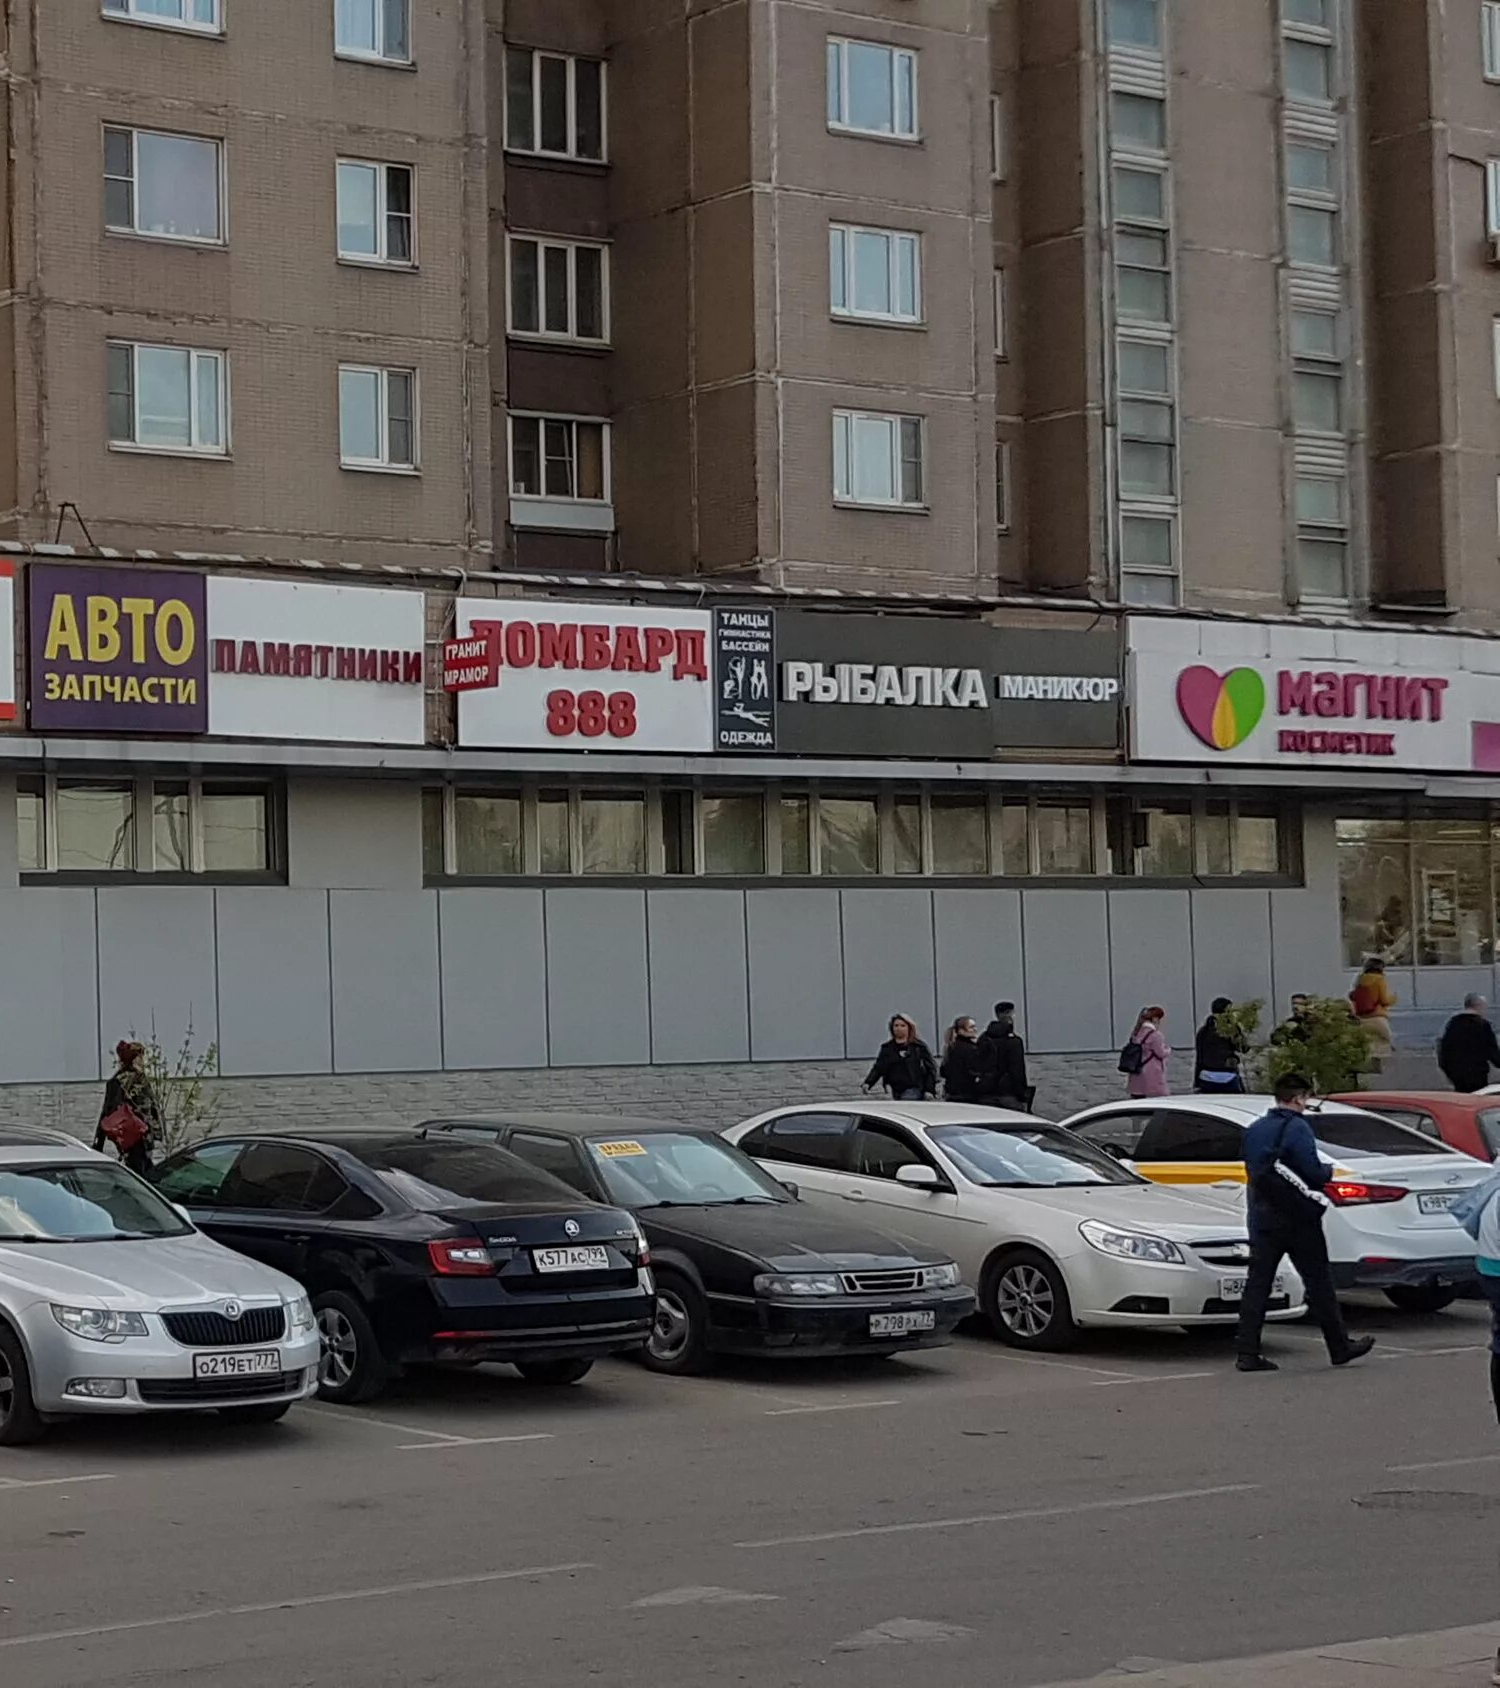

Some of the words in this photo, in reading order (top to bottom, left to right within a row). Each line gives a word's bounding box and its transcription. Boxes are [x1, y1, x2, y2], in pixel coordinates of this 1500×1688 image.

[44, 594, 195, 666] АВТО
[721, 613, 769, 629] ТАНЦЫ
[445, 640, 487, 661] ГРАНИТ
[721, 640, 770, 652] БАССЕЙН
[211, 639, 421, 684] ПАМЯТНИКИ
[44, 672, 197, 705] ЗАПЧАСТИ
[444, 665, 489, 686] МРАМОР
[782, 661, 989, 708] РЫБАЛКА
[999, 674, 1118, 701] МАНИКЮР
[546, 689, 637, 738] 888
[720, 731, 773, 745] ОДЕЖДА
